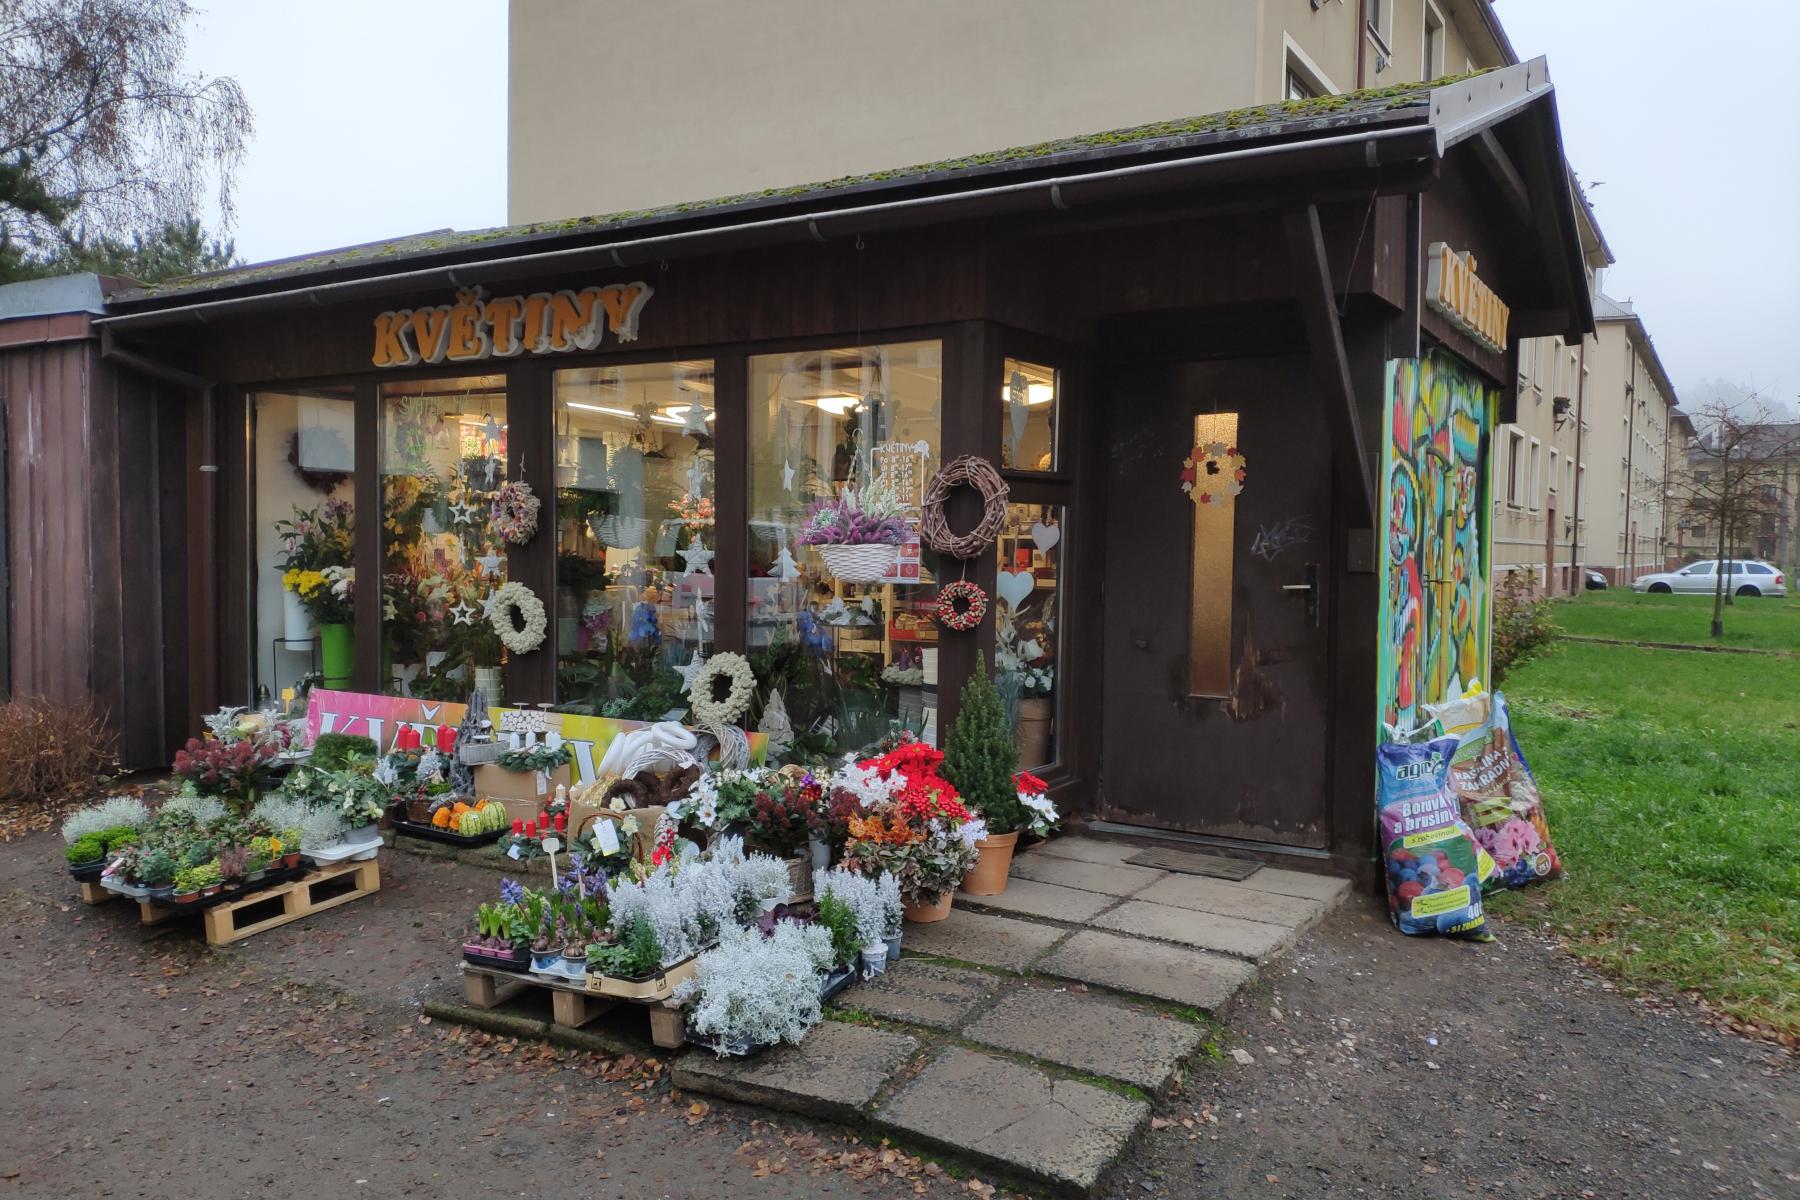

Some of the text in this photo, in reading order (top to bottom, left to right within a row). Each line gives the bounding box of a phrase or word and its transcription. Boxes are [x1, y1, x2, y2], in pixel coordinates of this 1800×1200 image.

[1438, 242, 1509, 353] KVĚTINY
[372, 281, 654, 367] KVĚTINY
[880, 441, 914, 453] KVĚTINY
[1394, 821, 1402, 834] a
